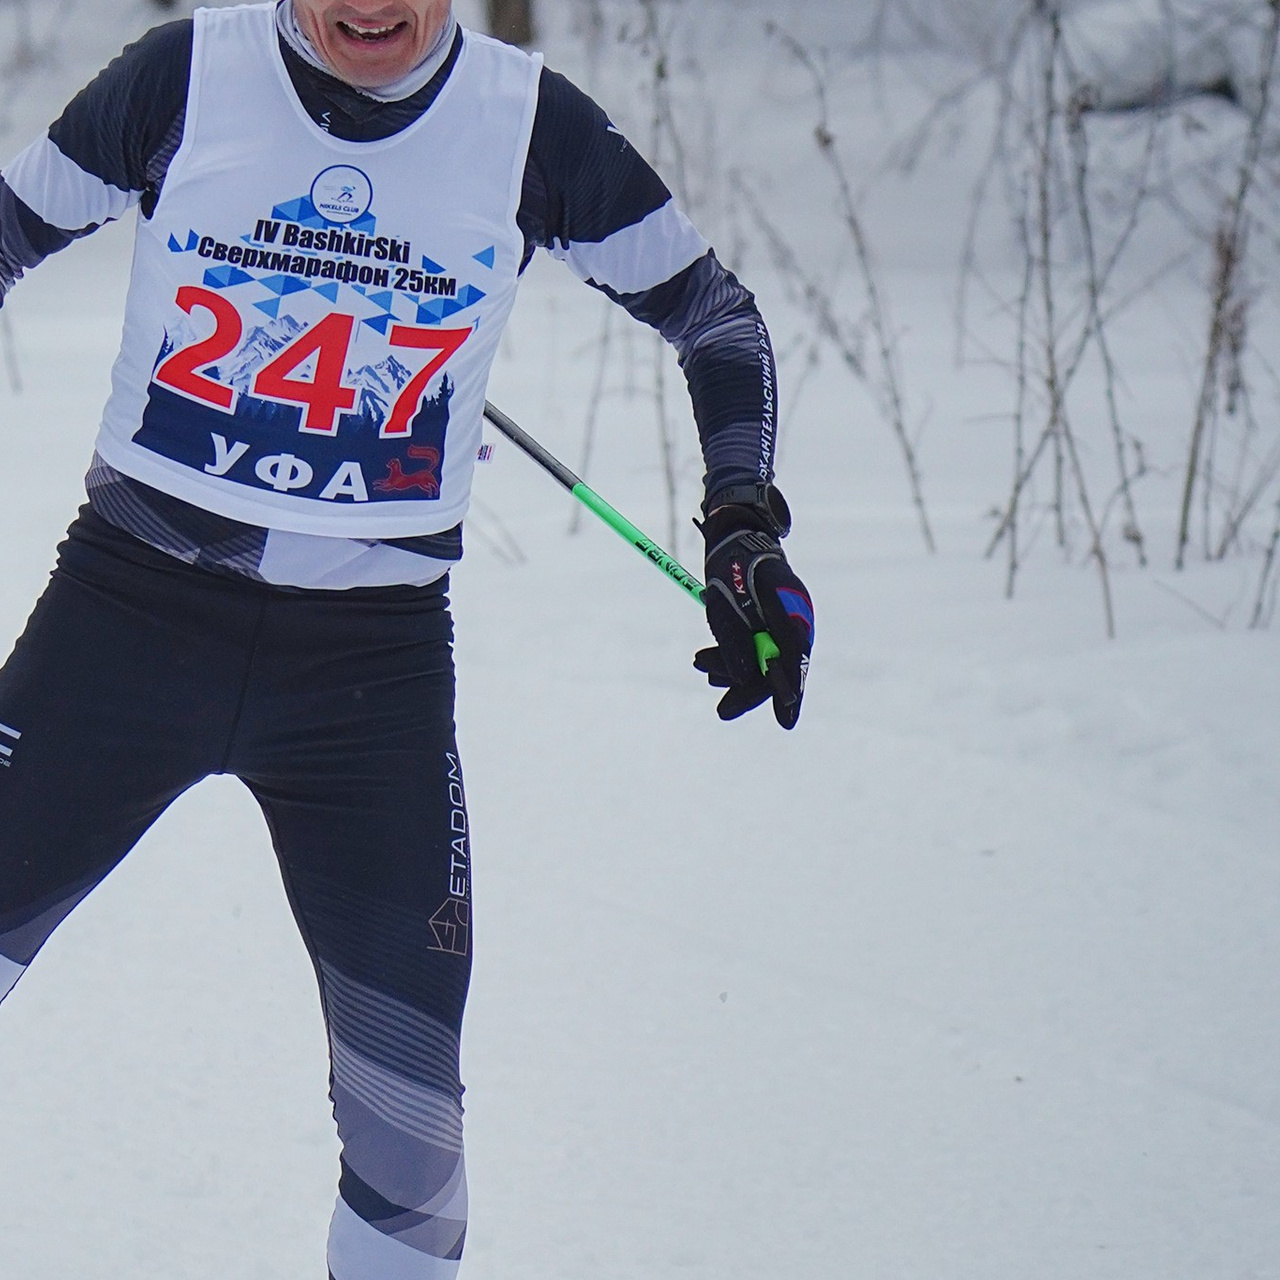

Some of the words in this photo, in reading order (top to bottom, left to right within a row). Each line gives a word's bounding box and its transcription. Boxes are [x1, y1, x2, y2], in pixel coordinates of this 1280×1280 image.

[253, 219, 280, 242] IV
[282, 223, 411, 264] BashkirSki
[343, 205, 359, 214] CLUB
[197, 236, 389, 287] Сверхмарафон
[394, 267, 457, 296] 25км
[152, 284, 475, 439] 247
[759, 350, 774, 481] РХАНГЕЛЬСКИЙ
[203, 433, 370, 502] УФА
[446, 752, 467, 897] ETADOM
